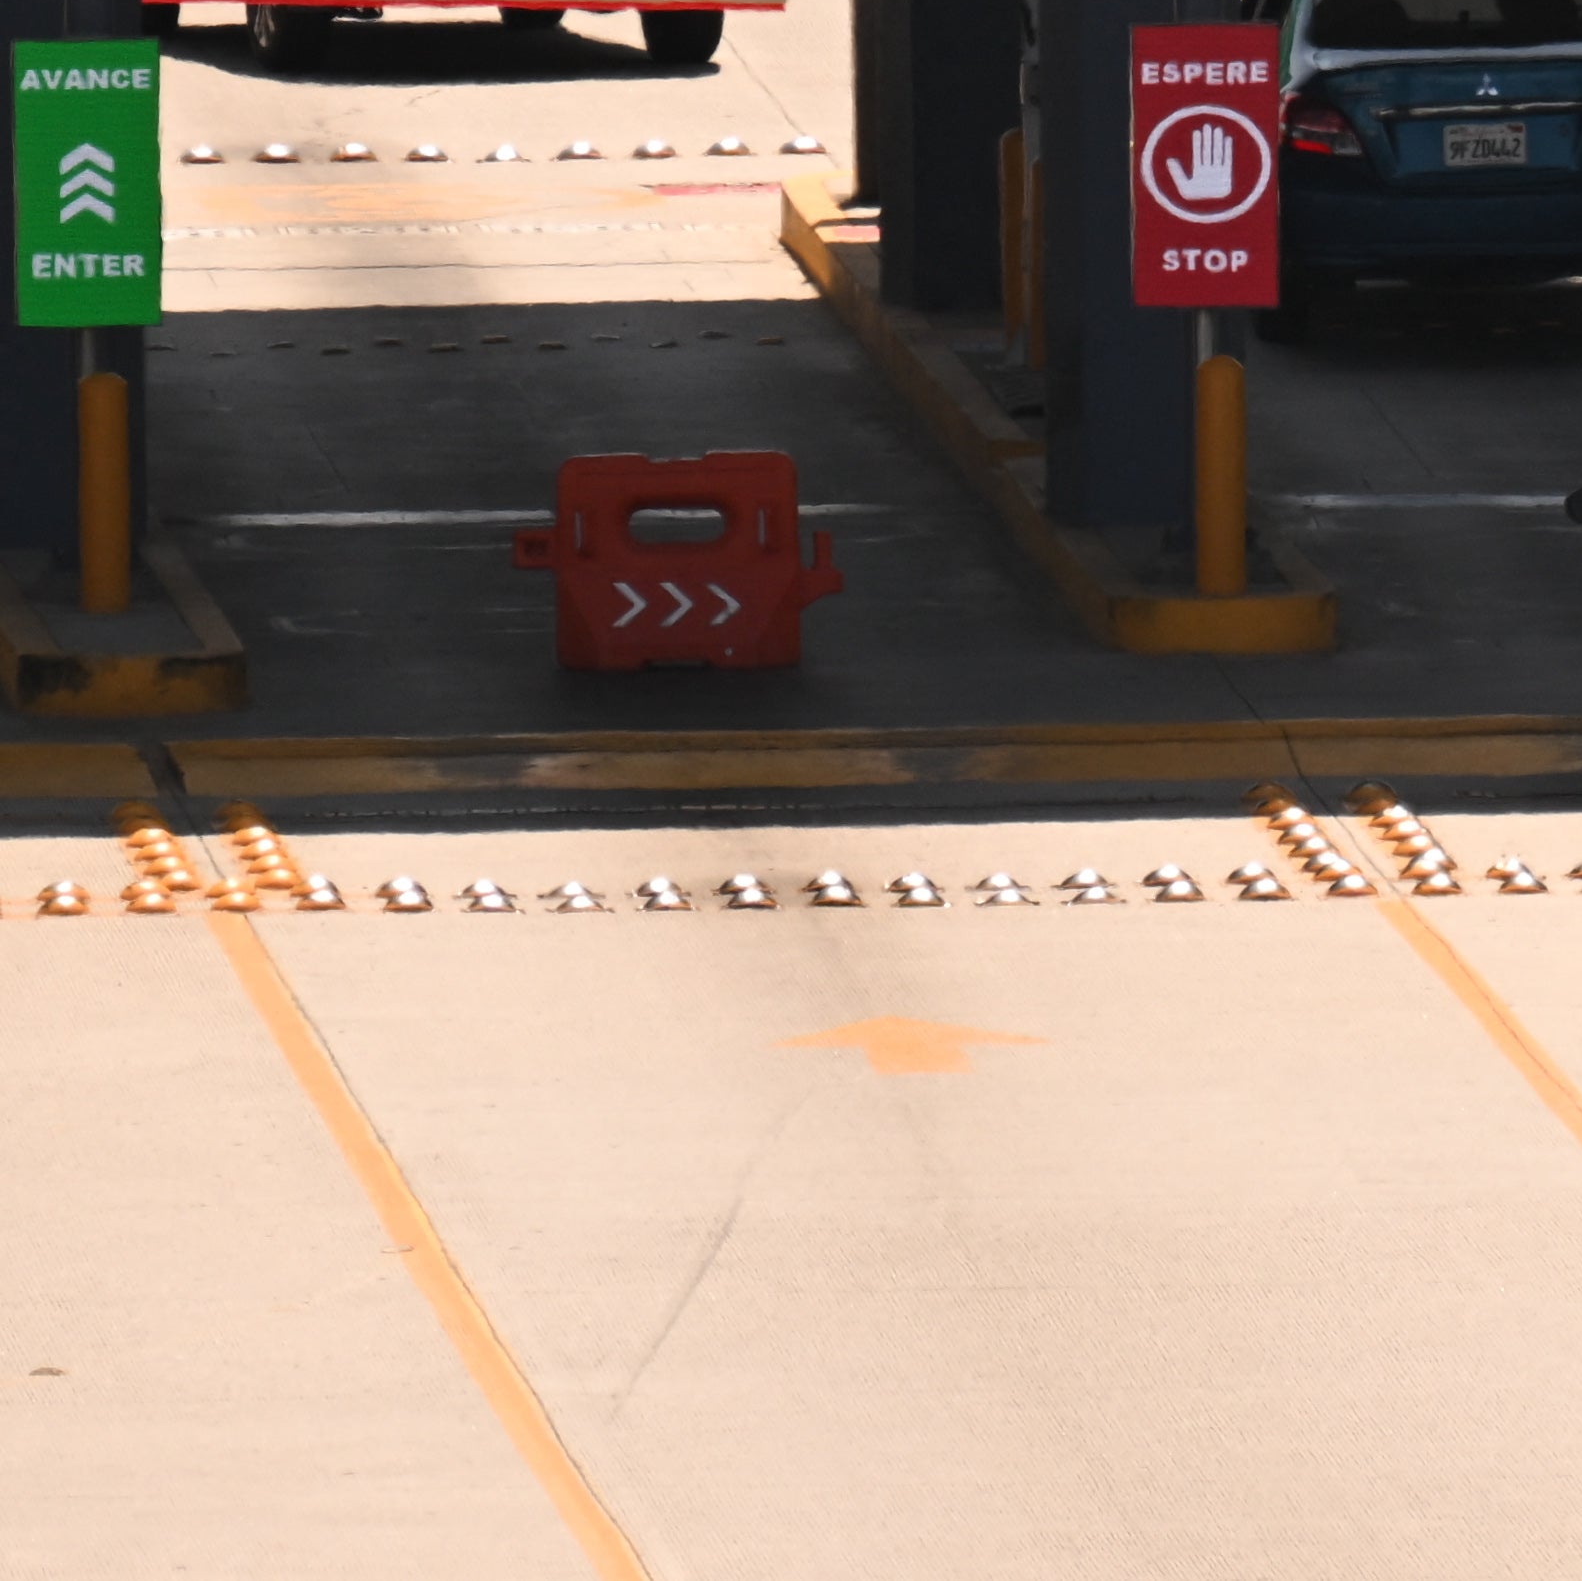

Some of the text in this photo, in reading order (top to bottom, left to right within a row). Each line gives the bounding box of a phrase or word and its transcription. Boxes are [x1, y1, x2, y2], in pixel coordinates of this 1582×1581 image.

[20, 68, 153, 91] AVANCE
[1141, 61, 1269, 86] ESPERE
[31, 253, 146, 280] ENTER
[1162, 249, 1250, 274] STOP
